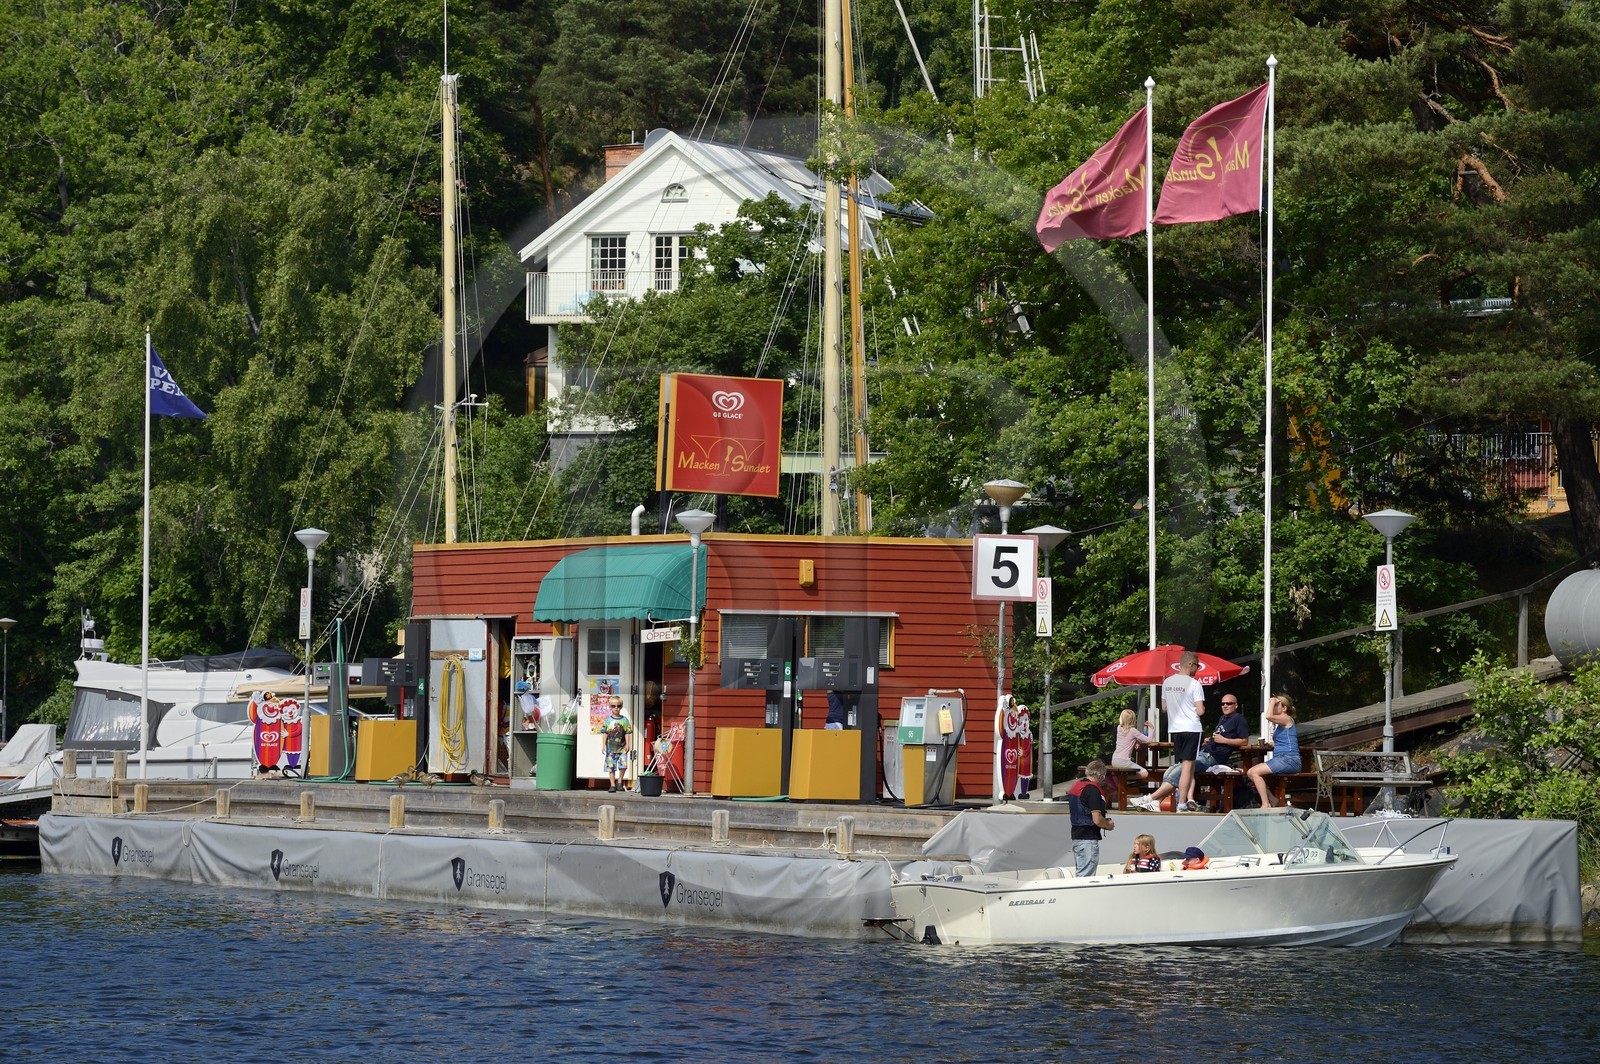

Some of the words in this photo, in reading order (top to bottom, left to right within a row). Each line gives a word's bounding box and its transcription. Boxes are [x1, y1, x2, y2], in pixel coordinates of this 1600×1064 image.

[722, 412, 742, 420] GLACE
[677, 450, 720, 470] Macken
[730, 455, 771, 473] Sundet
[991, 546, 1020, 589] 5
[785, 666, 791, 676] 6
[1197, 676, 1214, 684] ACE
[418, 682, 424, 690] 4
[123, 845, 155, 867] Gransegel
[283, 858, 320, 883] Gransegel
[466, 867, 507, 895] Gransegel
[676, 882, 724, 912] Gransegel
[1008, 899, 1045, 907] BERTRAM
